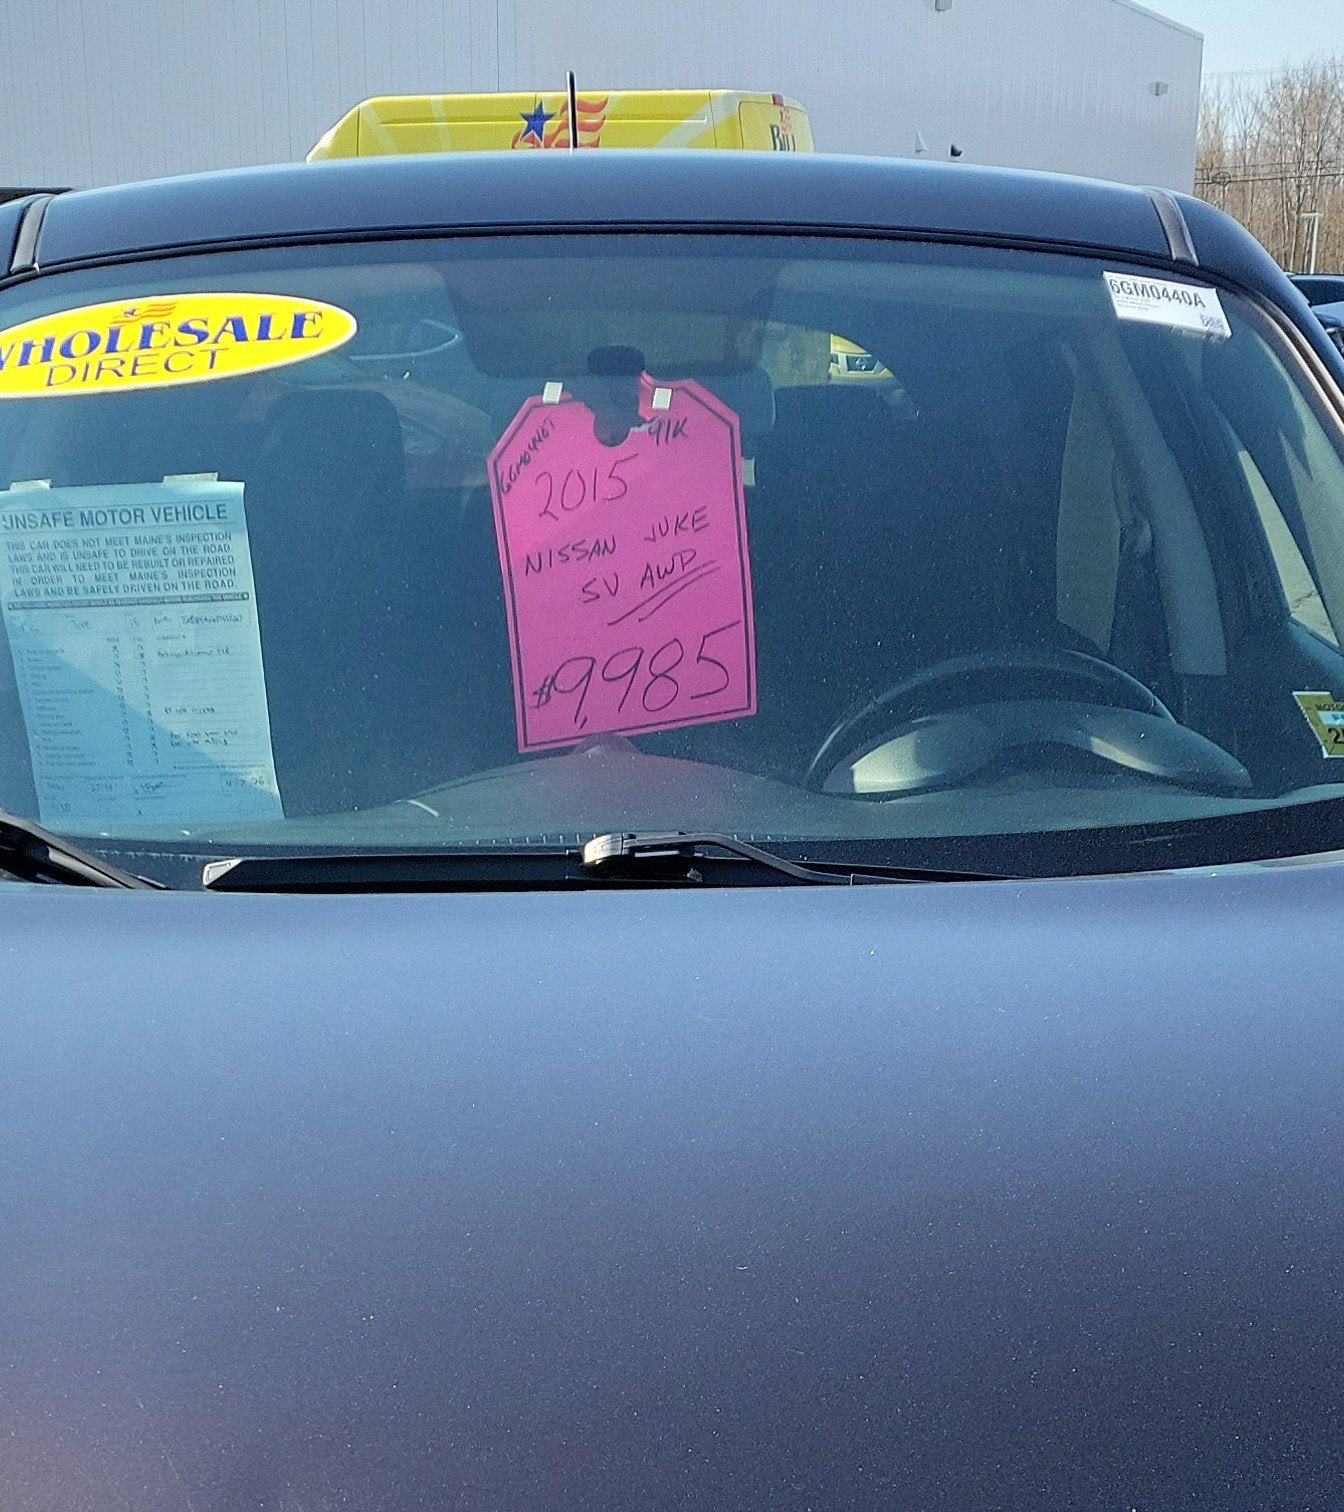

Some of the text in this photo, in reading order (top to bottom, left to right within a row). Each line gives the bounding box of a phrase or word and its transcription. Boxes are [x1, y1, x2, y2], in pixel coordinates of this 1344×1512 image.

[1109, 278, 1206, 308] 6GM0440A
[46, 347, 228, 386] DIRECT
[535, 453, 639, 520] 2015
[2, 503, 228, 530] UNSAFE MOTOR VEHICLE
[54, 539, 78, 549] DOES
[82, 538, 100, 548] NOT
[105, 536, 130, 546] MEET
[176, 532, 232, 543] INSPECTION
[72, 549, 108, 560] UNSAFE
[114, 548, 126, 558] TO
[130, 546, 158, 557] DRIVE
[162, 546, 176, 556] ON
[180, 545, 198, 554] THE
[525, 506, 710, 576] NISSAN JUKE
[72, 574, 85, 584] TO
[94, 572, 119, 582] MEET
[177, 567, 236, 579] INSPECTION
[76, 561, 100, 571] NEED
[103, 561, 115, 571] TO
[188, 555, 235, 567] REPAIRED
[582, 548, 697, 604] SV AWD
[83, 584, 119, 594] SAFELY
[122, 582, 161, 593] DRIVEN
[163, 582, 178, 591] ON
[181, 580, 203, 590] THE
